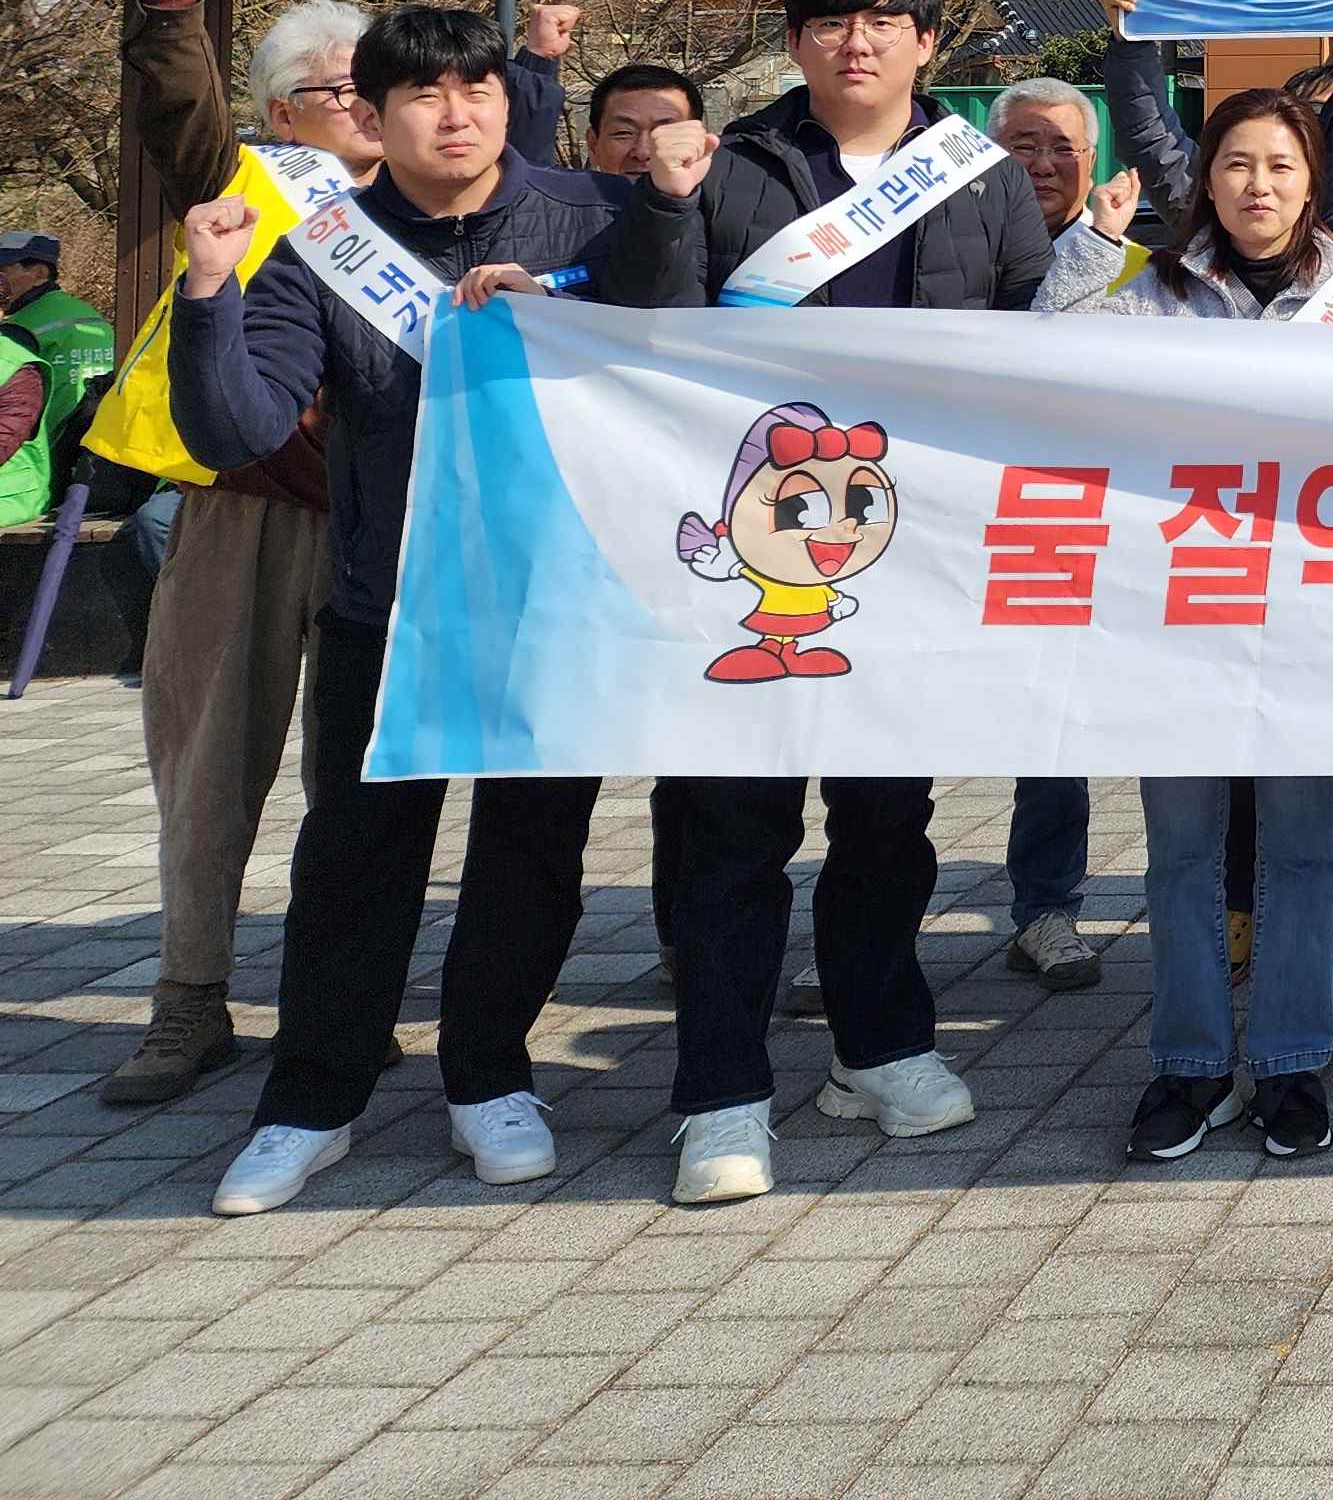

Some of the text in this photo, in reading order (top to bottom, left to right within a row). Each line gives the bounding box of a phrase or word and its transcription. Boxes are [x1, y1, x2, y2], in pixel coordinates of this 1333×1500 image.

[942, 124, 993, 169] 명을
[845, 154, 949, 238] 살리는
[303, 204, 377, 277] 약은
[980, 465, 1111, 627] 물
